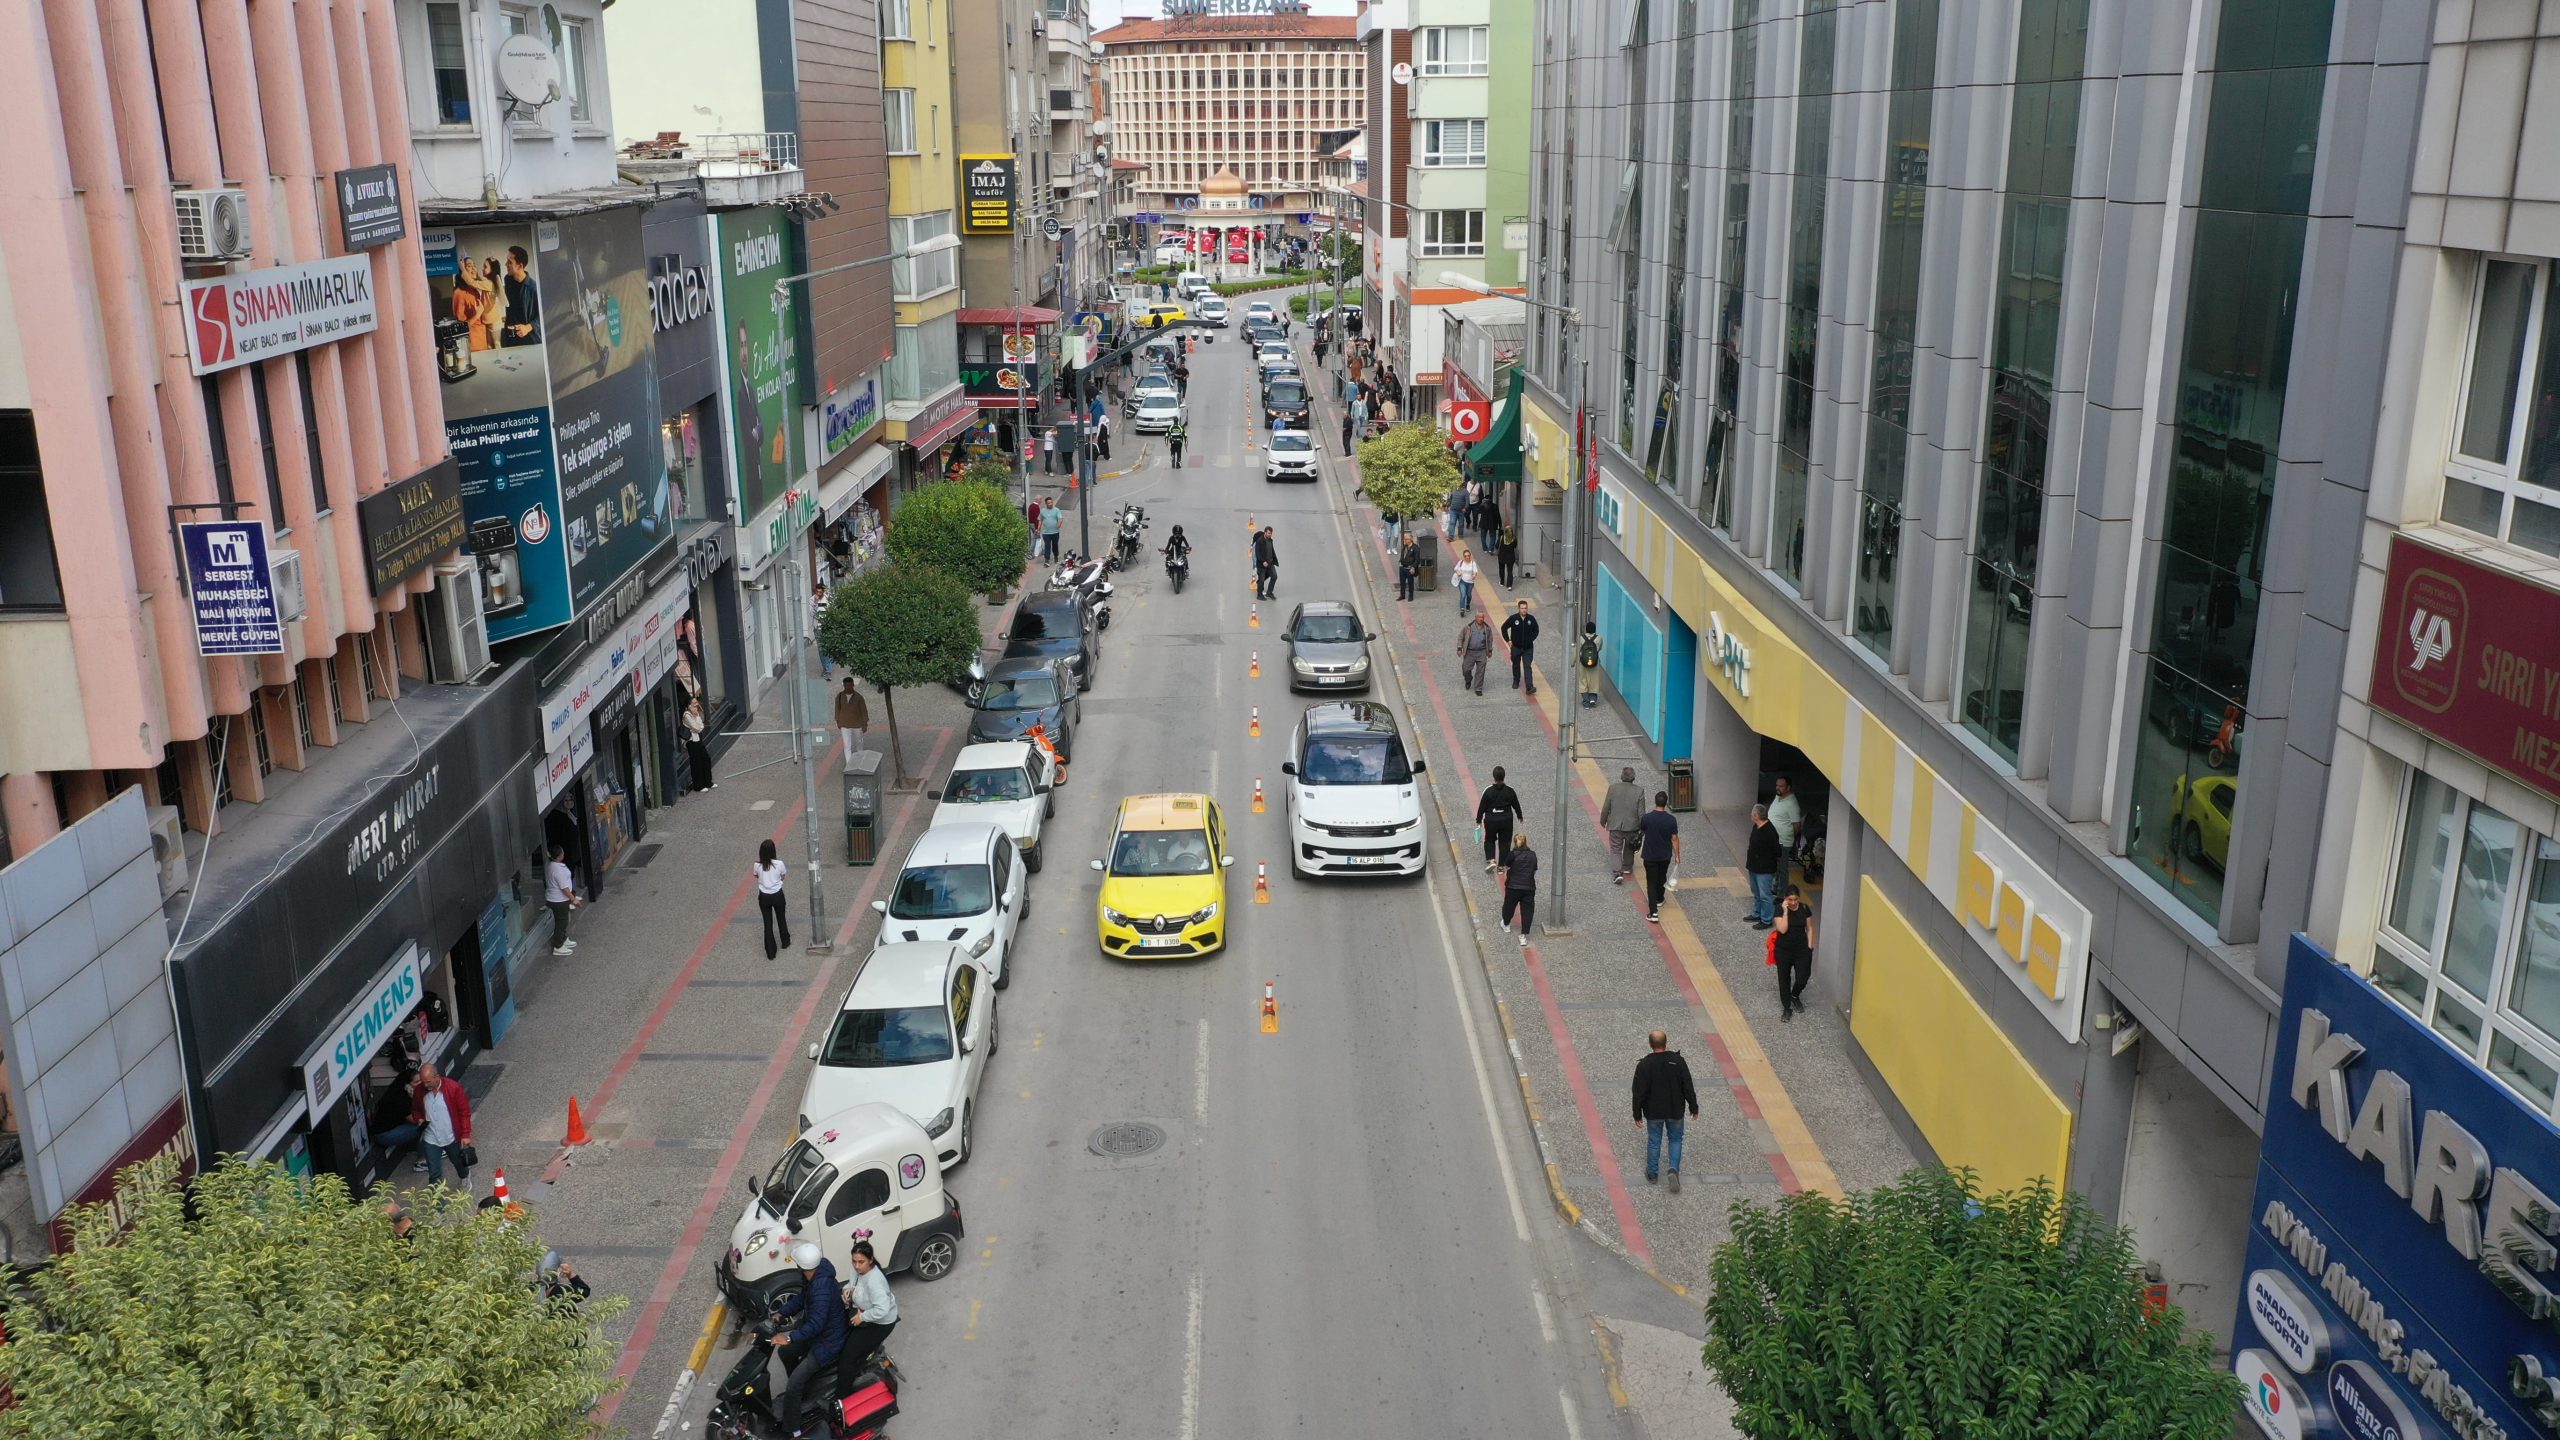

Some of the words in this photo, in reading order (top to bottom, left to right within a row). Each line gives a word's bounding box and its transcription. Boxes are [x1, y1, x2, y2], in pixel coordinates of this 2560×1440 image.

[357, 181, 384, 200] AVUKAT
[971, 173, 1006, 187] İMAJ
[975, 188, 1004, 196] Kuaför
[735, 225, 781, 277] EMİNEVİM
[647, 253, 714, 334] addax
[239, 337, 258, 353] NEJAT
[282, 331, 297, 343] mimar
[305, 323, 323, 338] SİNAN
[343, 315, 359, 332] yüksek
[359, 312, 372, 325] mimar
[447, 427, 459, 437] bir
[460, 422, 499, 436] kahvenin
[500, 414, 539, 429] arkasında
[479, 432, 511, 445] Philips
[511, 427, 540, 440] vardır
[560, 418, 578, 442] Philips
[577, 417, 590, 434] Aqua
[589, 411, 600, 427] Trio
[562, 447, 578, 475] Tek
[577, 439, 608, 467] süpürge
[607, 429, 613, 450] 3
[613, 421, 632, 450] işlem
[591, 469, 603, 490] çeker
[602, 467, 609, 476] ve
[398, 479, 433, 515] YALIN
[374, 523, 404, 554] HUKUK
[410, 495, 459, 533] DANIŞMANLIK
[204, 570, 254, 582] SERBEST
[386, 560, 404, 579] Tuğba
[403, 548, 420, 568] YALIN
[197, 586, 269, 602] MUHASEBECİ
[200, 606, 225, 619] MALİ
[226, 605, 272, 620] MÜŞAVİR
[201, 632, 239, 642] MERVE
[240, 630, 278, 641] GÜVEN
[611, 645, 625, 670] Fakir
[2477, 643, 2537, 709] SIRRI
[571, 685, 591, 712] Tefal
[550, 704, 570, 734] PHILIPS
[600, 701, 615, 730] MERT
[572, 729, 591, 756] SUNNY
[2511, 725, 2560, 782] MEZ
[347, 809, 388, 876] MERT
[393, 764, 440, 833] MURAT
[377, 851, 398, 883] LTD.
[401, 823, 420, 865] ŞTİ.
[1359, 856, 1371, 864] ALP
[334, 964, 415, 1080] SIEMENS
[2290, 1007, 2560, 1320] KARE
[2261, 1199, 2327, 1277] AYNI
[2255, 1282, 2309, 1346] ANADOLU
[2334, 1373, 2382, 1437] Allianz
